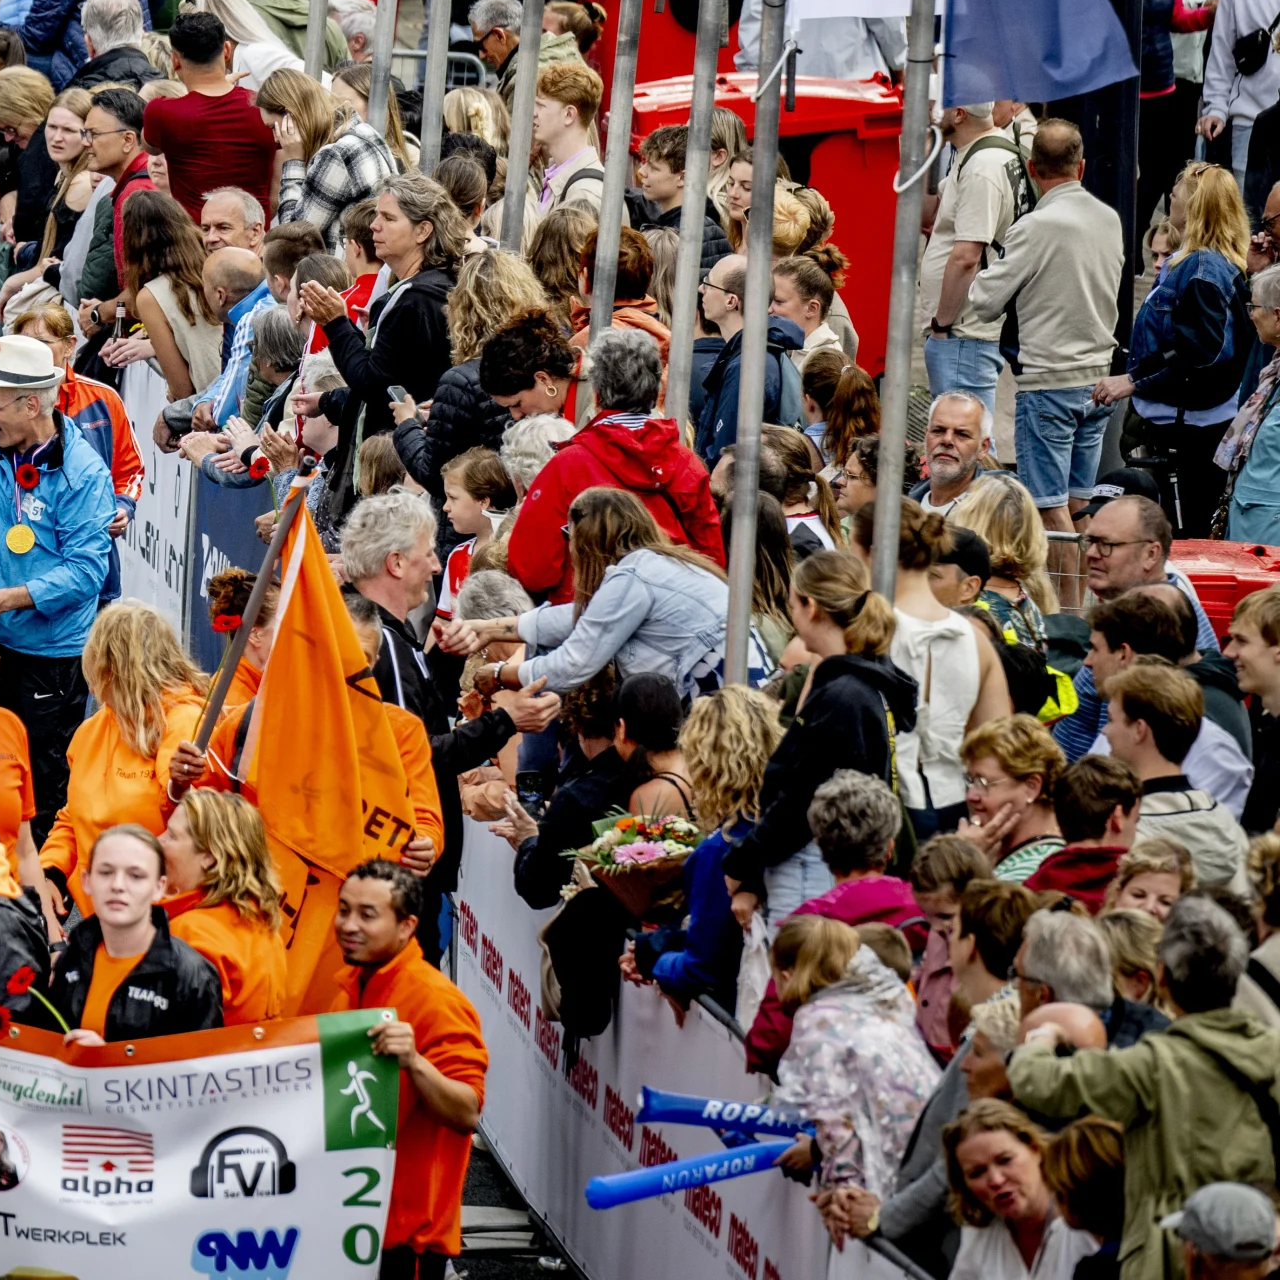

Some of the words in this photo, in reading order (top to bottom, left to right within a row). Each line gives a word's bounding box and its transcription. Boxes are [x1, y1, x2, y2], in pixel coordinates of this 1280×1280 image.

[481, 932, 503, 994] mateco
[507, 967, 531, 1032] mateco
[534, 1005, 560, 1070] mateco
[104, 1057, 312, 1104] SKINTASTICS
[242, 1082, 313, 1099] KLINIEK
[603, 1083, 634, 1153] mateco
[702, 1099, 792, 1129] ROPA
[60, 1176, 154, 1198] alpha
